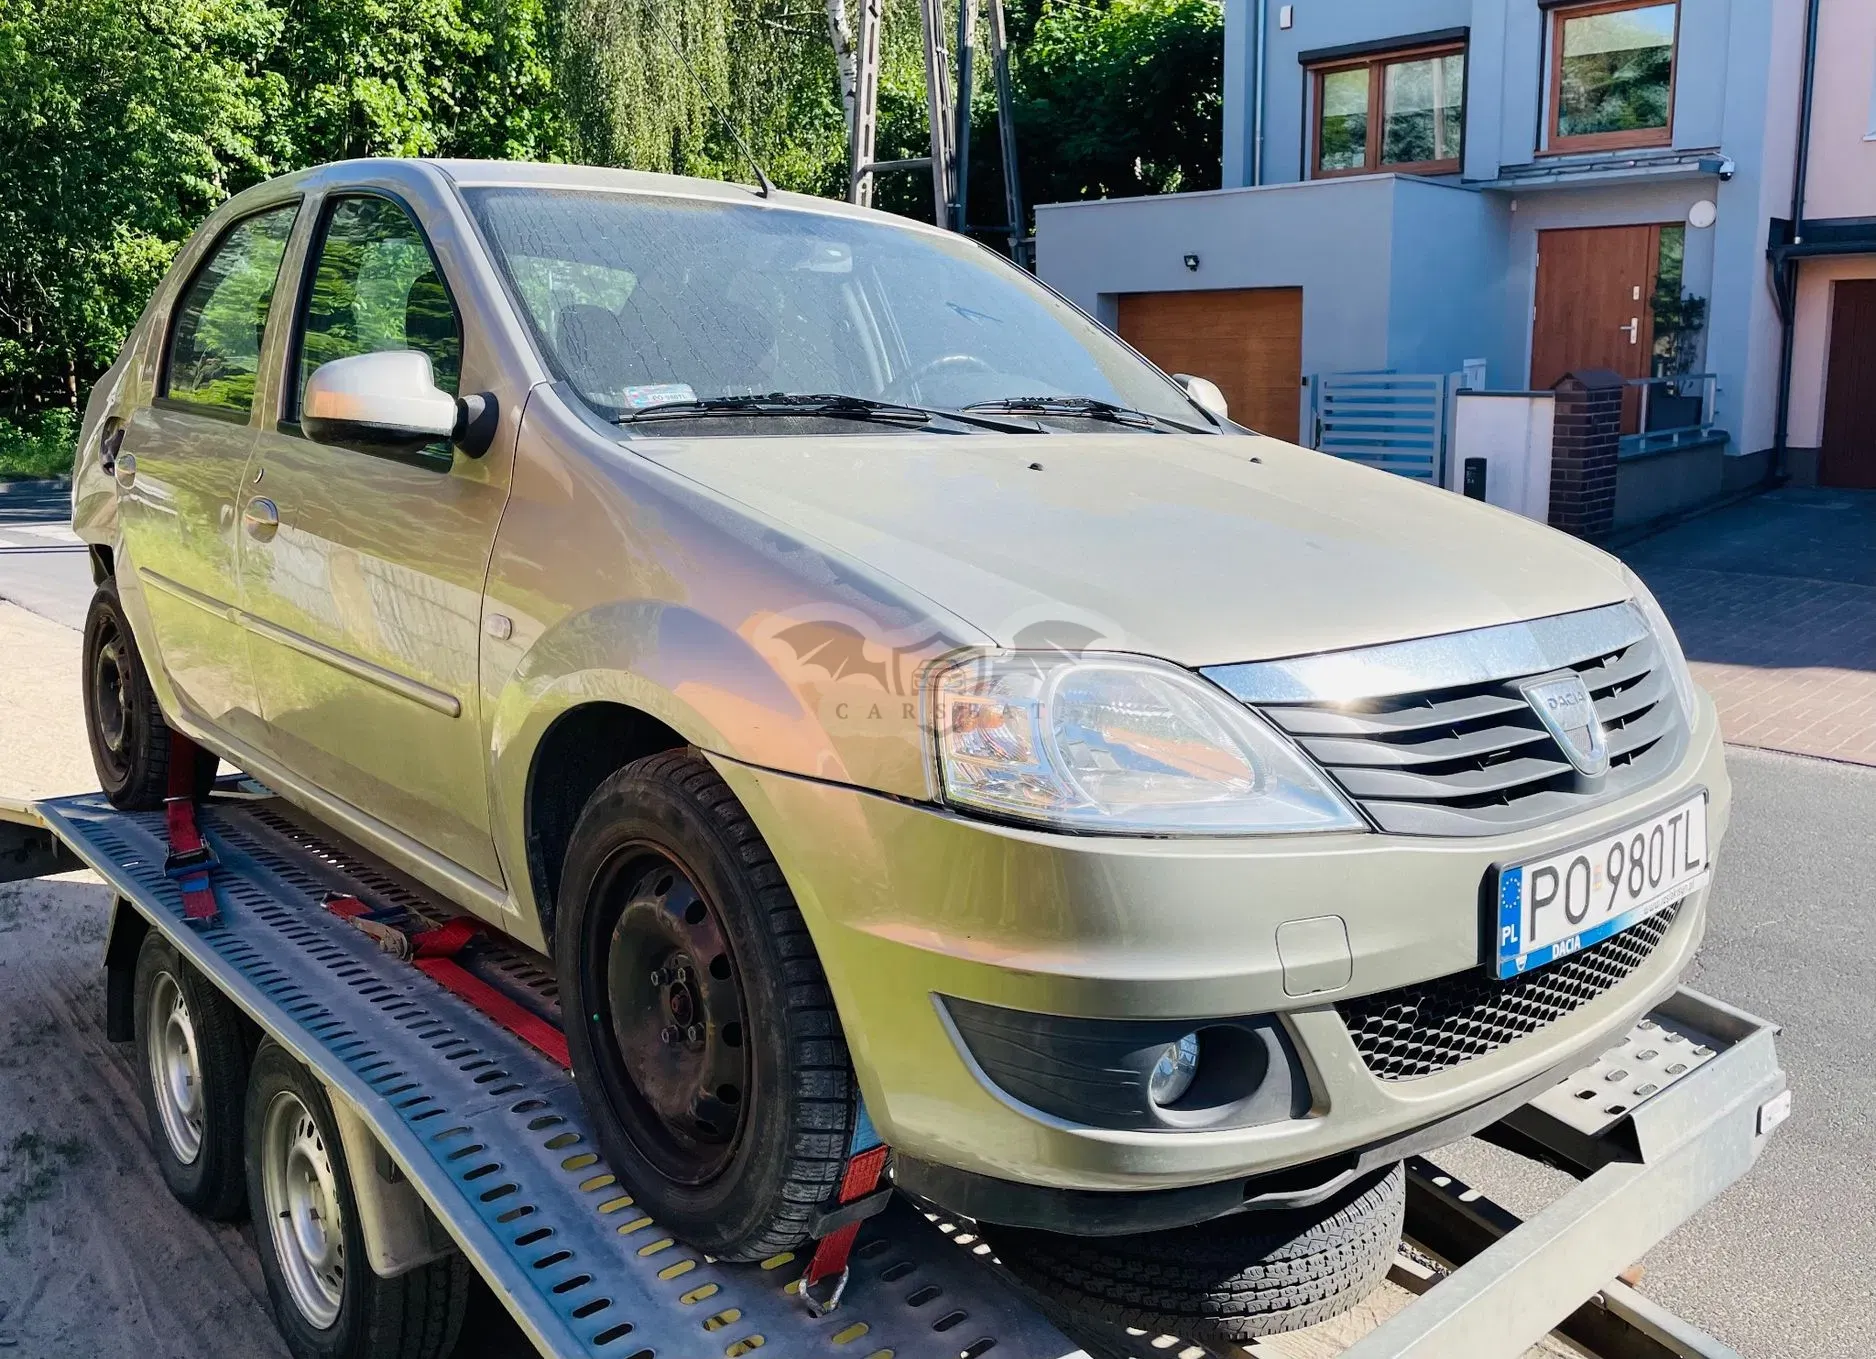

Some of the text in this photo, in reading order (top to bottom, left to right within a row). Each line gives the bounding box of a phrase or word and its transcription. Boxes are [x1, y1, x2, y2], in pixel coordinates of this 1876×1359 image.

[1547, 690, 1585, 709] DACIA
[1530, 809, 1701, 943] PO 980TL
[1502, 923, 1518, 947] PL
[1552, 934, 1580, 960] DACIA
